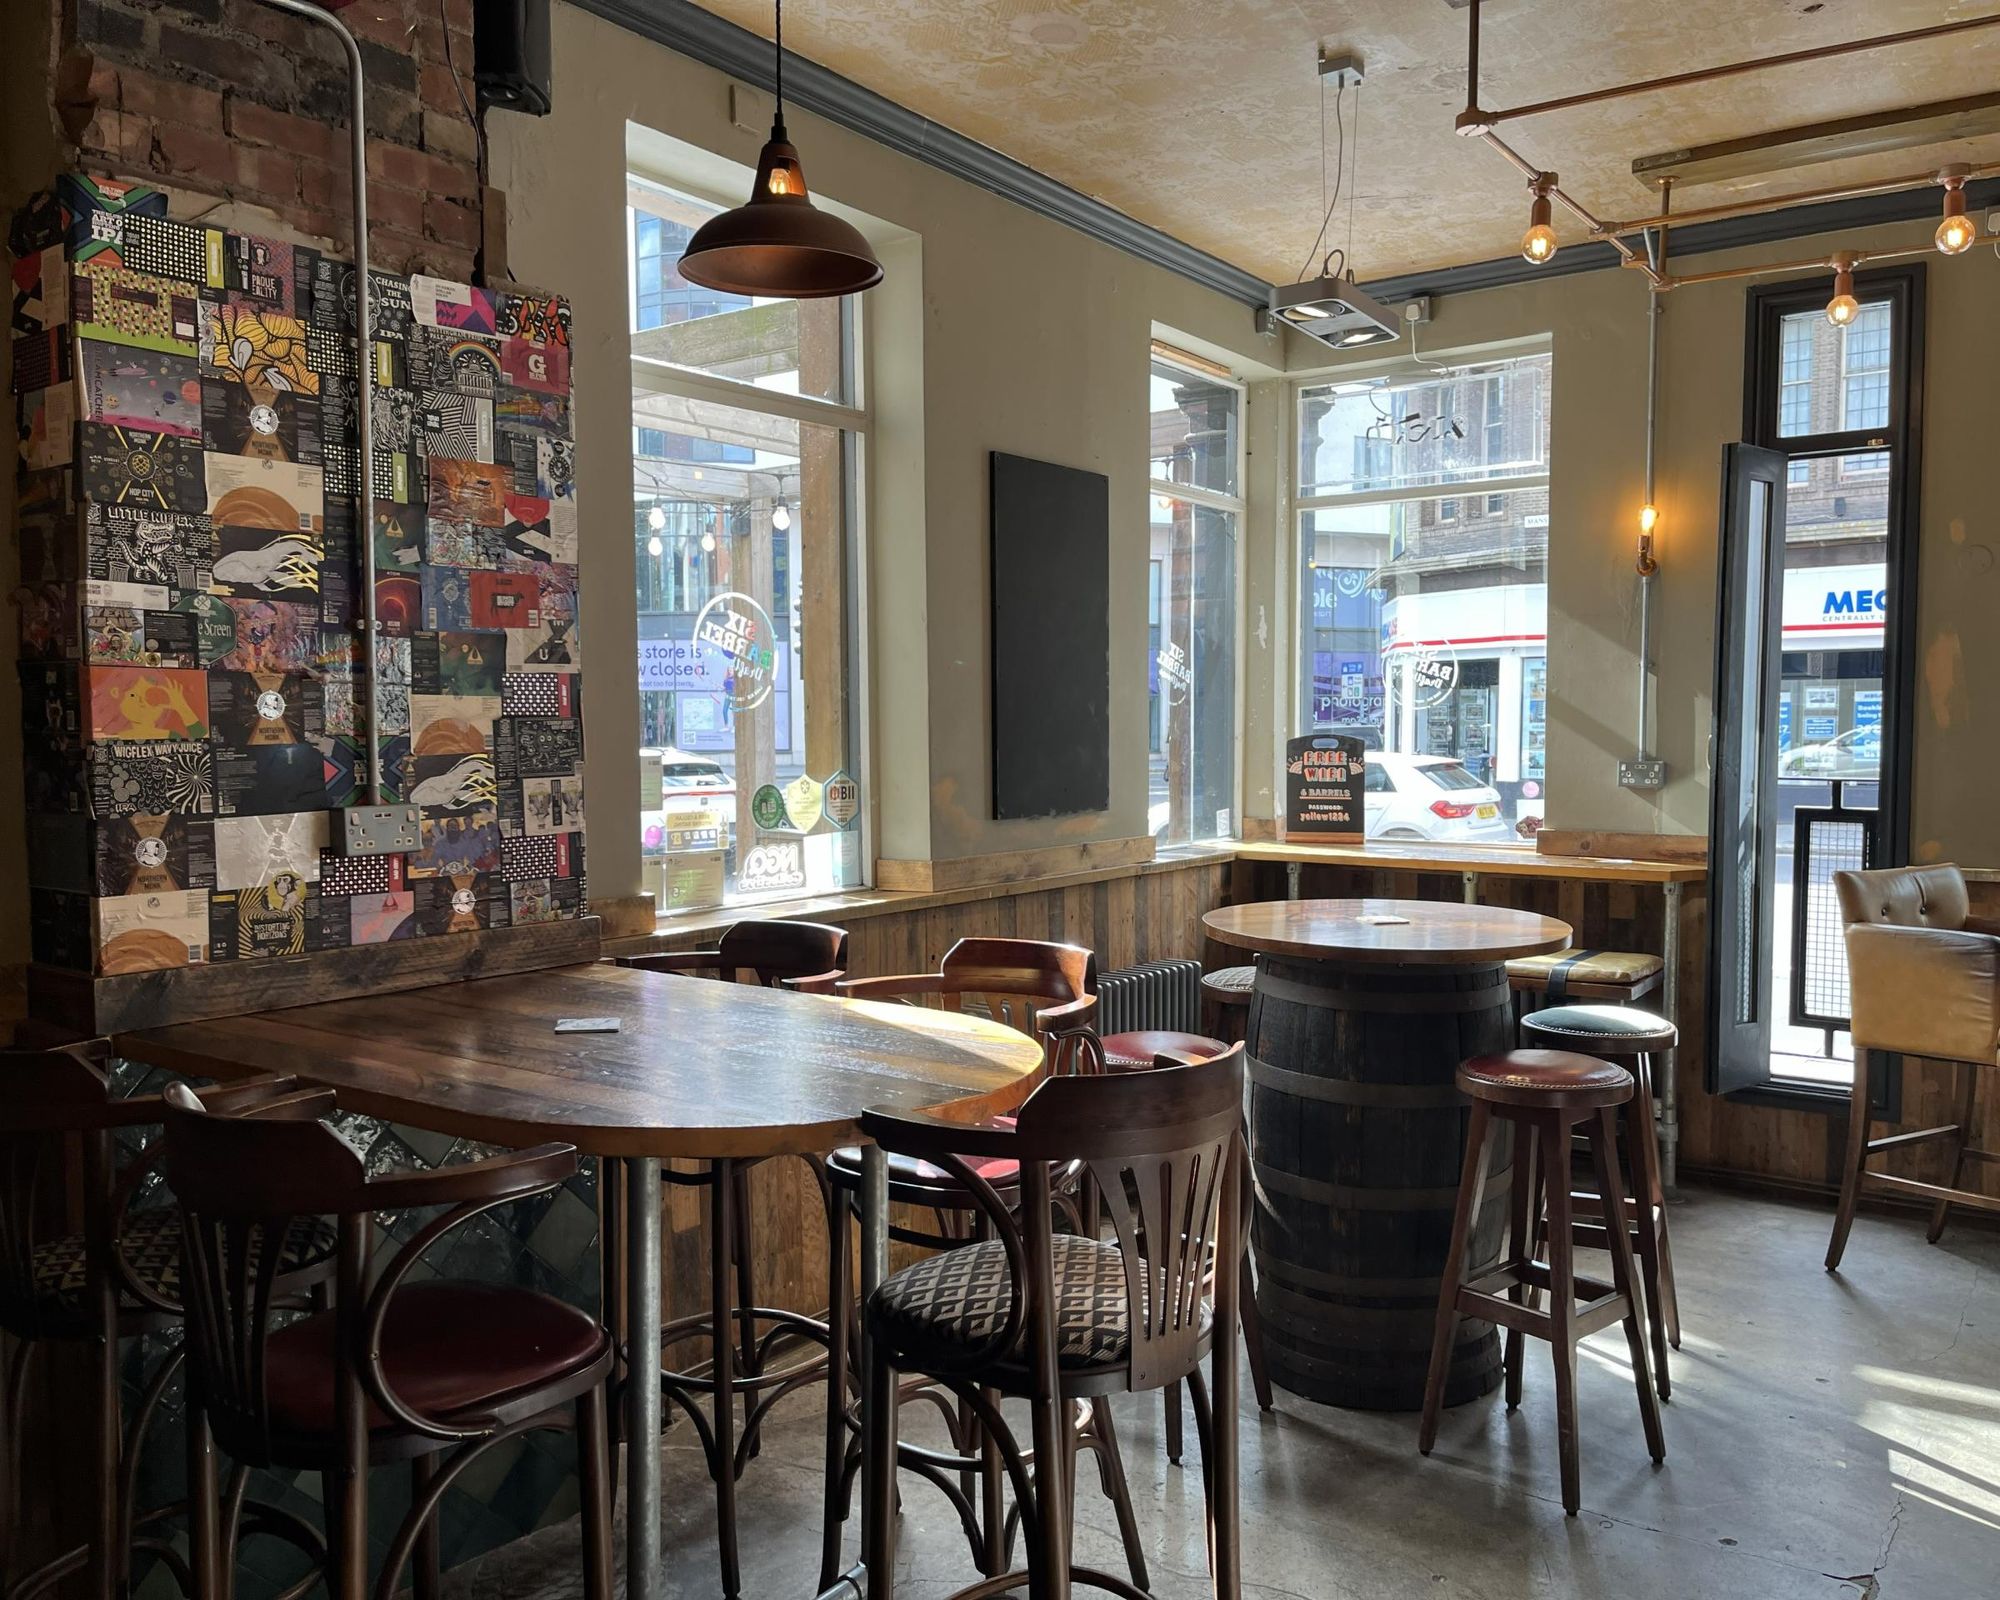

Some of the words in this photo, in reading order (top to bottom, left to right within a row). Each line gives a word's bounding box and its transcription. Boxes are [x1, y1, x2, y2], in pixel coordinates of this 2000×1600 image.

[92, 225, 123, 245] IPA
[387, 289, 402, 298] THE
[381, 298, 412, 310] SUN
[380, 329, 404, 340] IPA
[129, 488, 141, 497] HOP
[142, 489, 155, 498] CITY
[108, 506, 148, 521] LITTLE
[150, 511, 195, 528] NIPPER
[204, 618, 232, 637] Screen
[645, 645, 685, 658] store
[690, 644, 701, 658] is
[650, 662, 709, 676] closed.
[114, 745, 154, 758] WIGFLEX
[154, 745, 179, 757] WAVY
[179, 743, 203, 754] JUICE
[1303, 751, 1348, 766] FREE
[1304, 767, 1347, 782] WIFI
[1308, 788, 1351, 797] BARRELS
[115, 803, 137, 813] IPA
[254, 921, 290, 932] DISTORTING
[257, 930, 288, 941] HORIZONS
